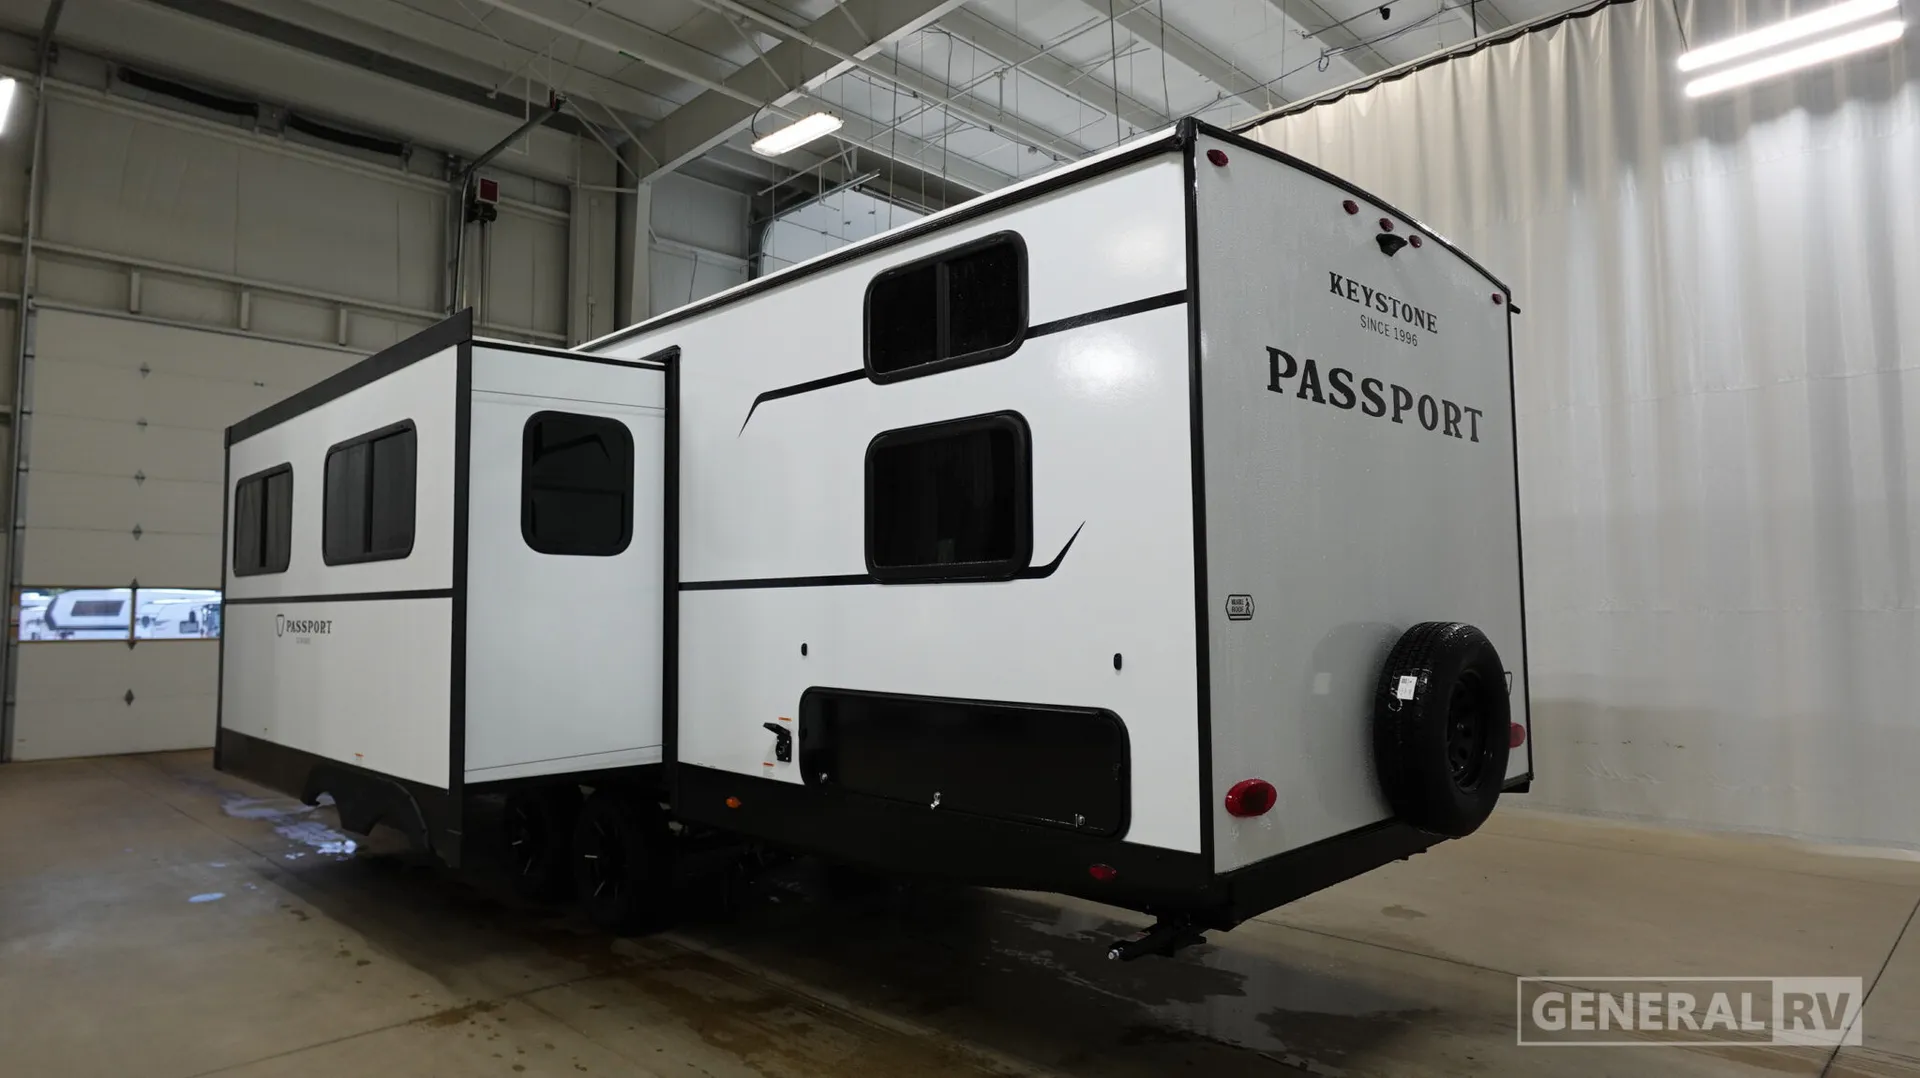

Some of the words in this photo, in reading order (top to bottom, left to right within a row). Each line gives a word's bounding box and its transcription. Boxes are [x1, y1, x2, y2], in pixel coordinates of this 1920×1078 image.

[1329, 271, 1438, 334] KEYSTONE
[1360, 314, 1390, 337] SINCE
[1394, 327, 1418, 347] 1996
[1266, 345, 1483, 443] PASSPORT
[286, 620, 332, 634] PASSPORT
